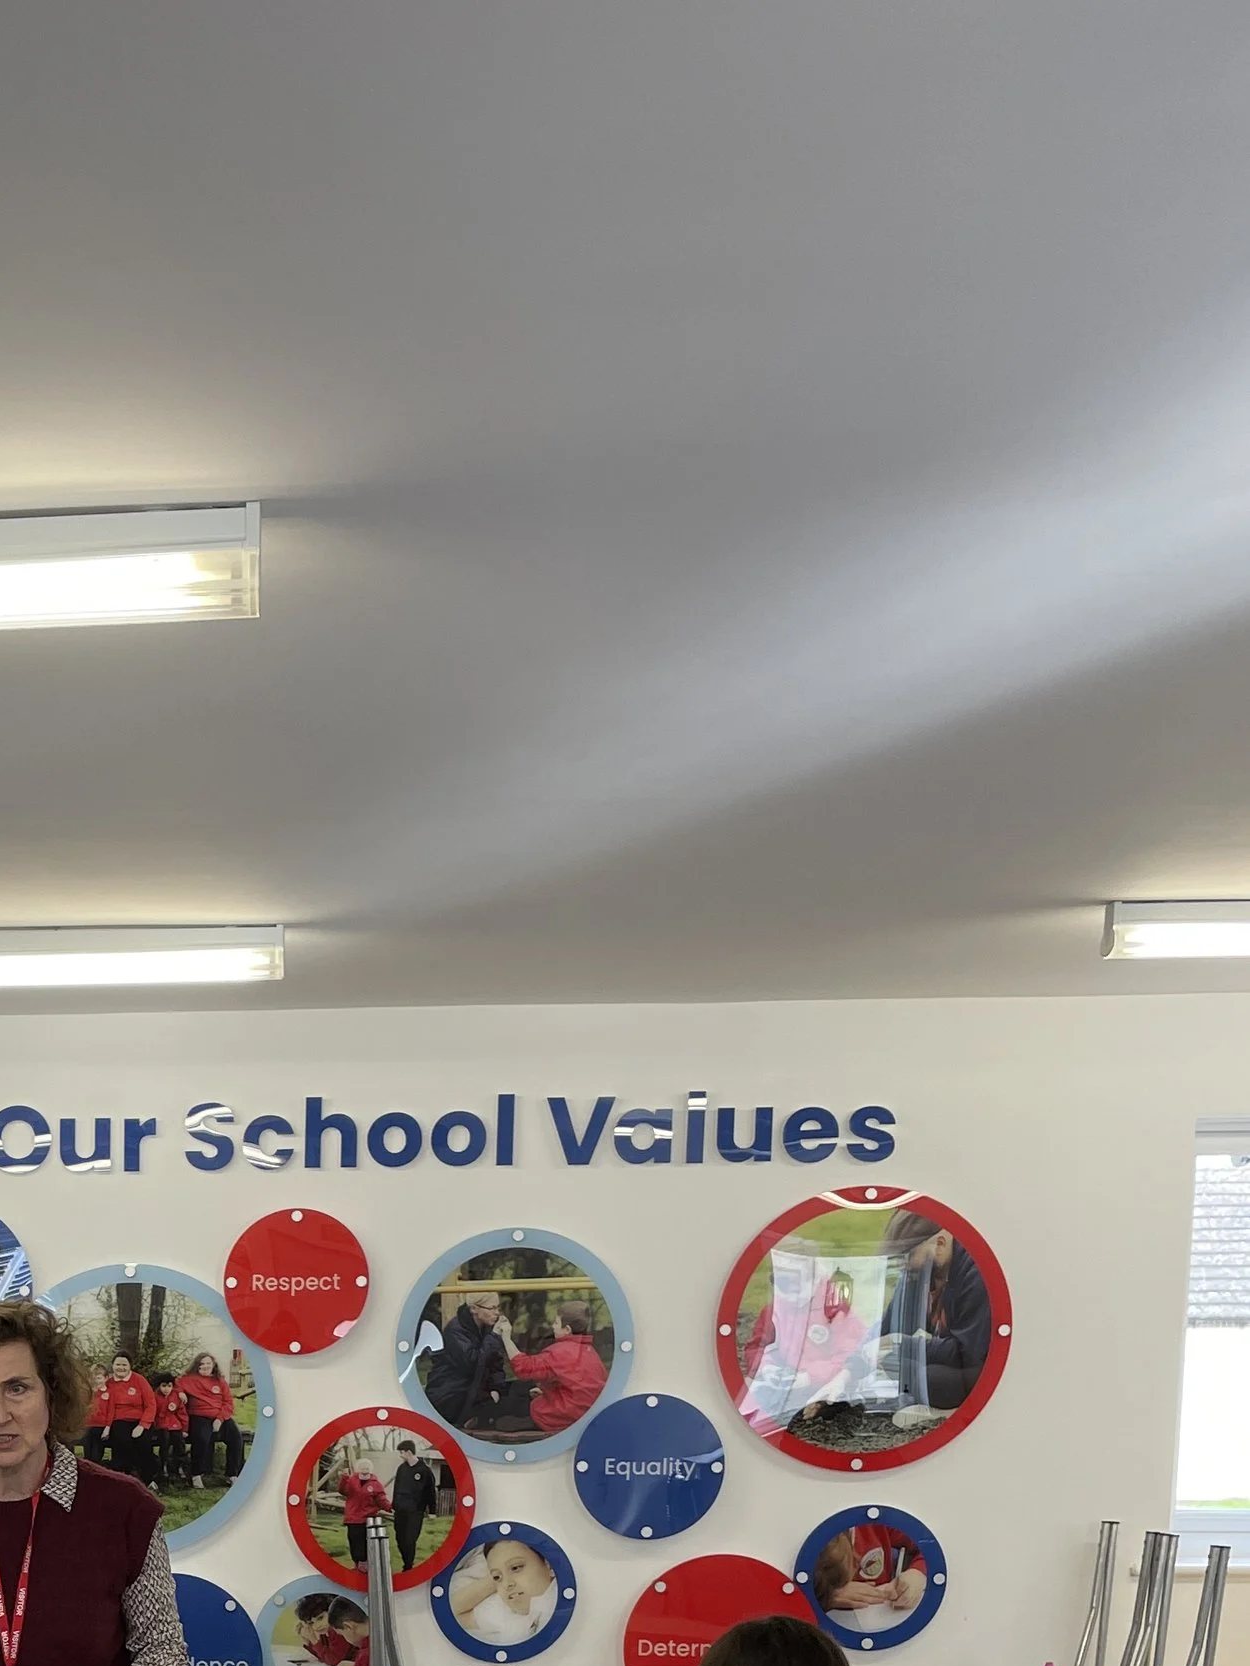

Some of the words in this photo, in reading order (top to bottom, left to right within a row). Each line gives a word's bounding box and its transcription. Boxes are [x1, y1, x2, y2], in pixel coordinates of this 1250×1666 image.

[184, 1093, 516, 1171] School
[546, 1090, 897, 1166] Values
[252, 1273, 340, 1296] Respect
[605, 1457, 696, 1481] Equality
[15, 1588, 27, 1616] VISITOR
[10, 1630, 20, 1659] VISITOR
